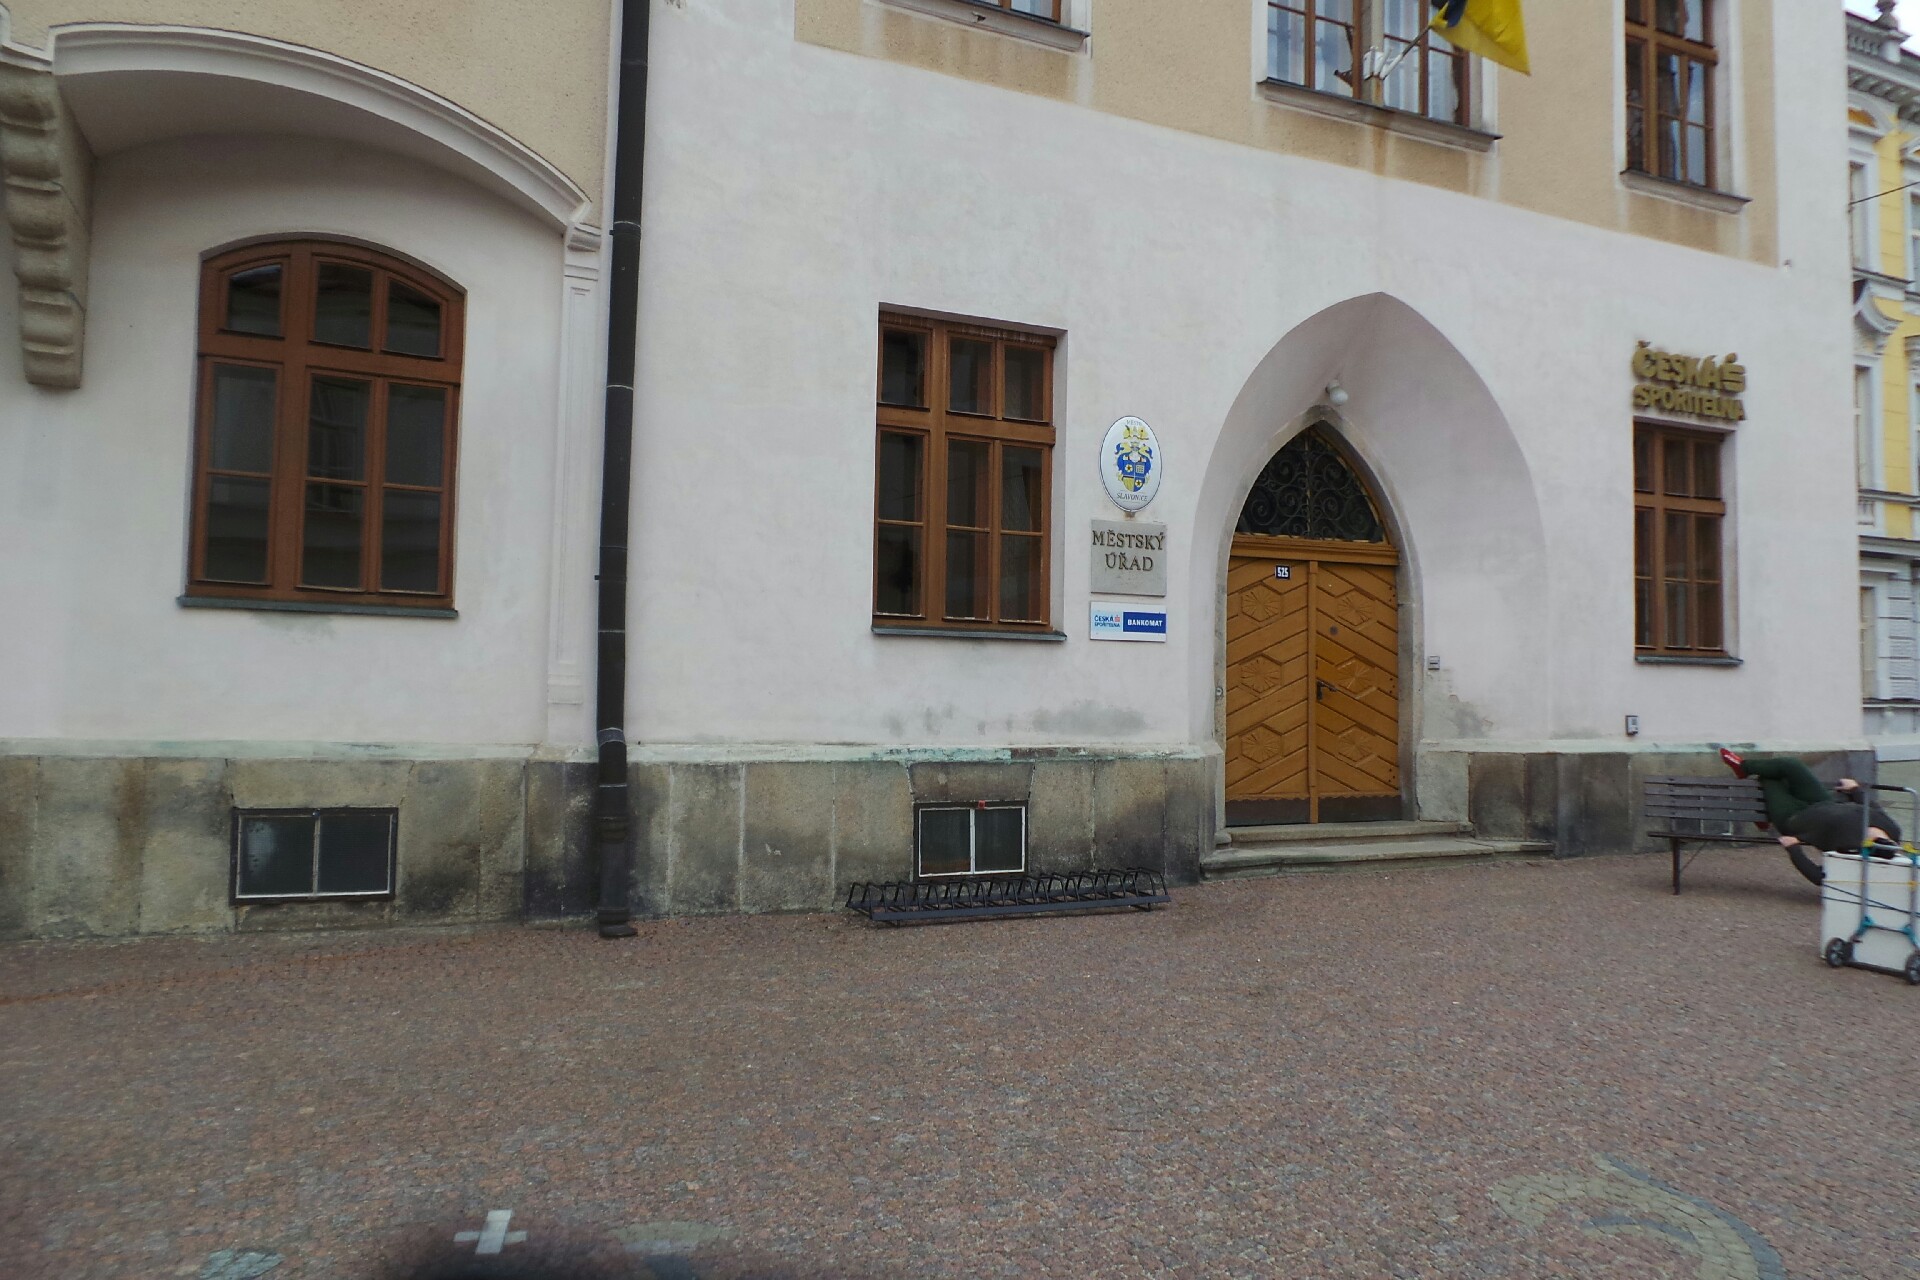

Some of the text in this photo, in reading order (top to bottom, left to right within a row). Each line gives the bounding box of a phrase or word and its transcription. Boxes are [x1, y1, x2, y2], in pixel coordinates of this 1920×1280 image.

[1632, 340, 1719, 390] ČESKÁ
[1092, 529, 1165, 550] MĚSTSKÝ
[1105, 551, 1154, 571] ÚŘAD
[1277, 566, 1289, 577] 525
[1094, 614, 1114, 622] ČESKÁ
[1127, 619, 1163, 627] BANKOMAT
